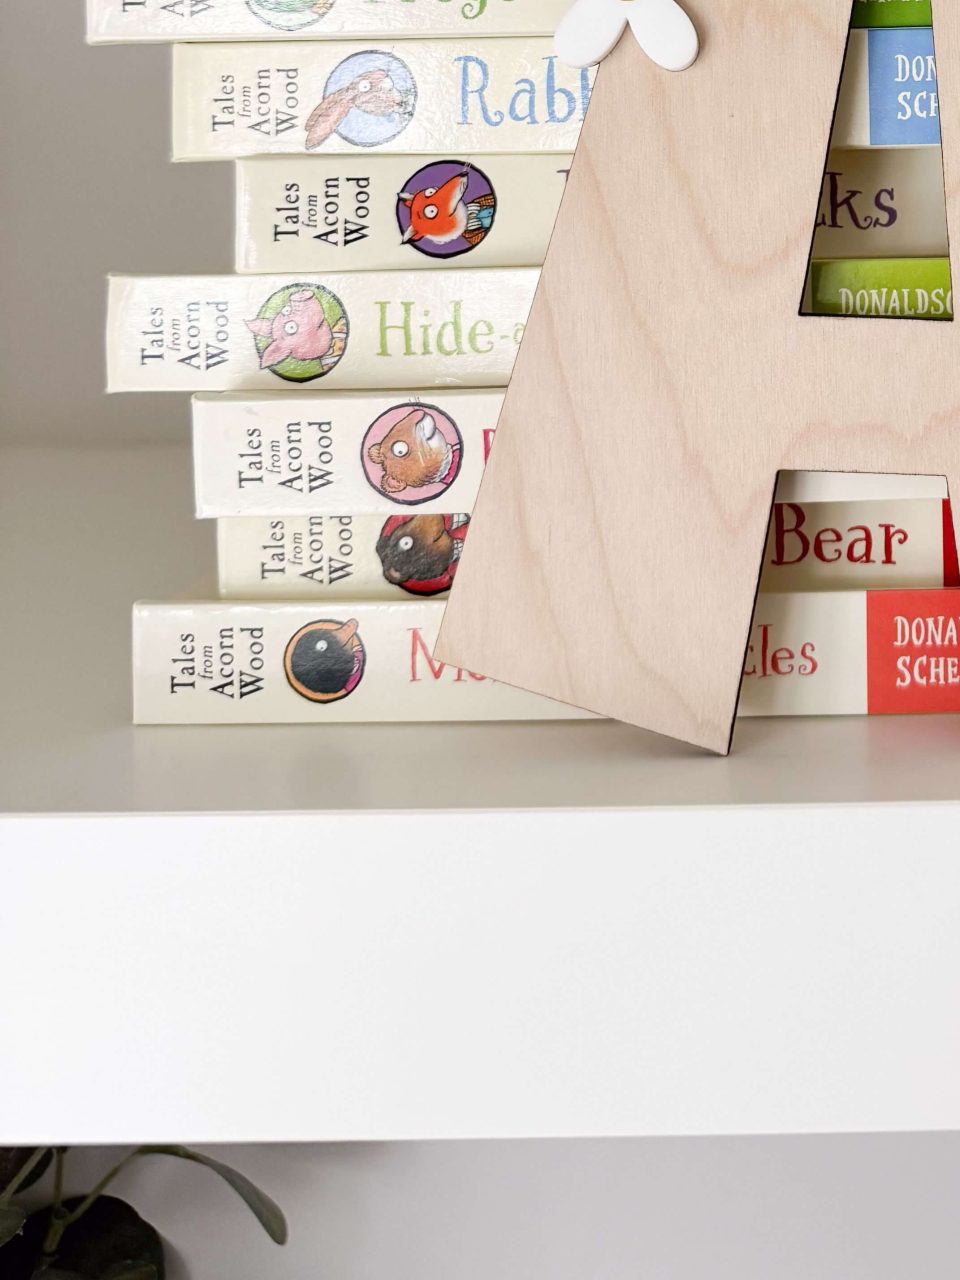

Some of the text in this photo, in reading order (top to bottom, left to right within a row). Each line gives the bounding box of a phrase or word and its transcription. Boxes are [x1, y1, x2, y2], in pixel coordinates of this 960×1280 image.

[212, 74, 235, 132] Tales
[236, 85, 252, 117] from
[246, 68, 271, 135] Acorn
[275, 67, 299, 136] Wood
[273, 182, 300, 242] Tales
[301, 194, 319, 228] from
[312, 177, 340, 247] Acorn
[343, 176, 370, 247] Wood
[815, 172, 898, 230] ks
[839, 287, 953, 316] DONALDS
[140, 307, 164, 365] Tales
[166, 318, 182, 352] from
[177, 301, 202, 371] Acorn
[205, 300, 230, 371] Wood
[238, 427, 263, 488] Tales
[265, 439, 282, 474] from
[277, 421, 303, 493] Acorn
[307, 420, 334, 493] Wood
[261, 520, 286, 580] Tales
[288, 532, 303, 566] from
[299, 516, 324, 585] Acorn
[328, 515, 353, 585] Wood
[771, 502, 908, 566] Bear
[170, 632, 196, 694] Tales
[197, 644, 214, 680] from
[209, 627, 235, 700] Acorn
[239, 626, 265, 700] Wood
